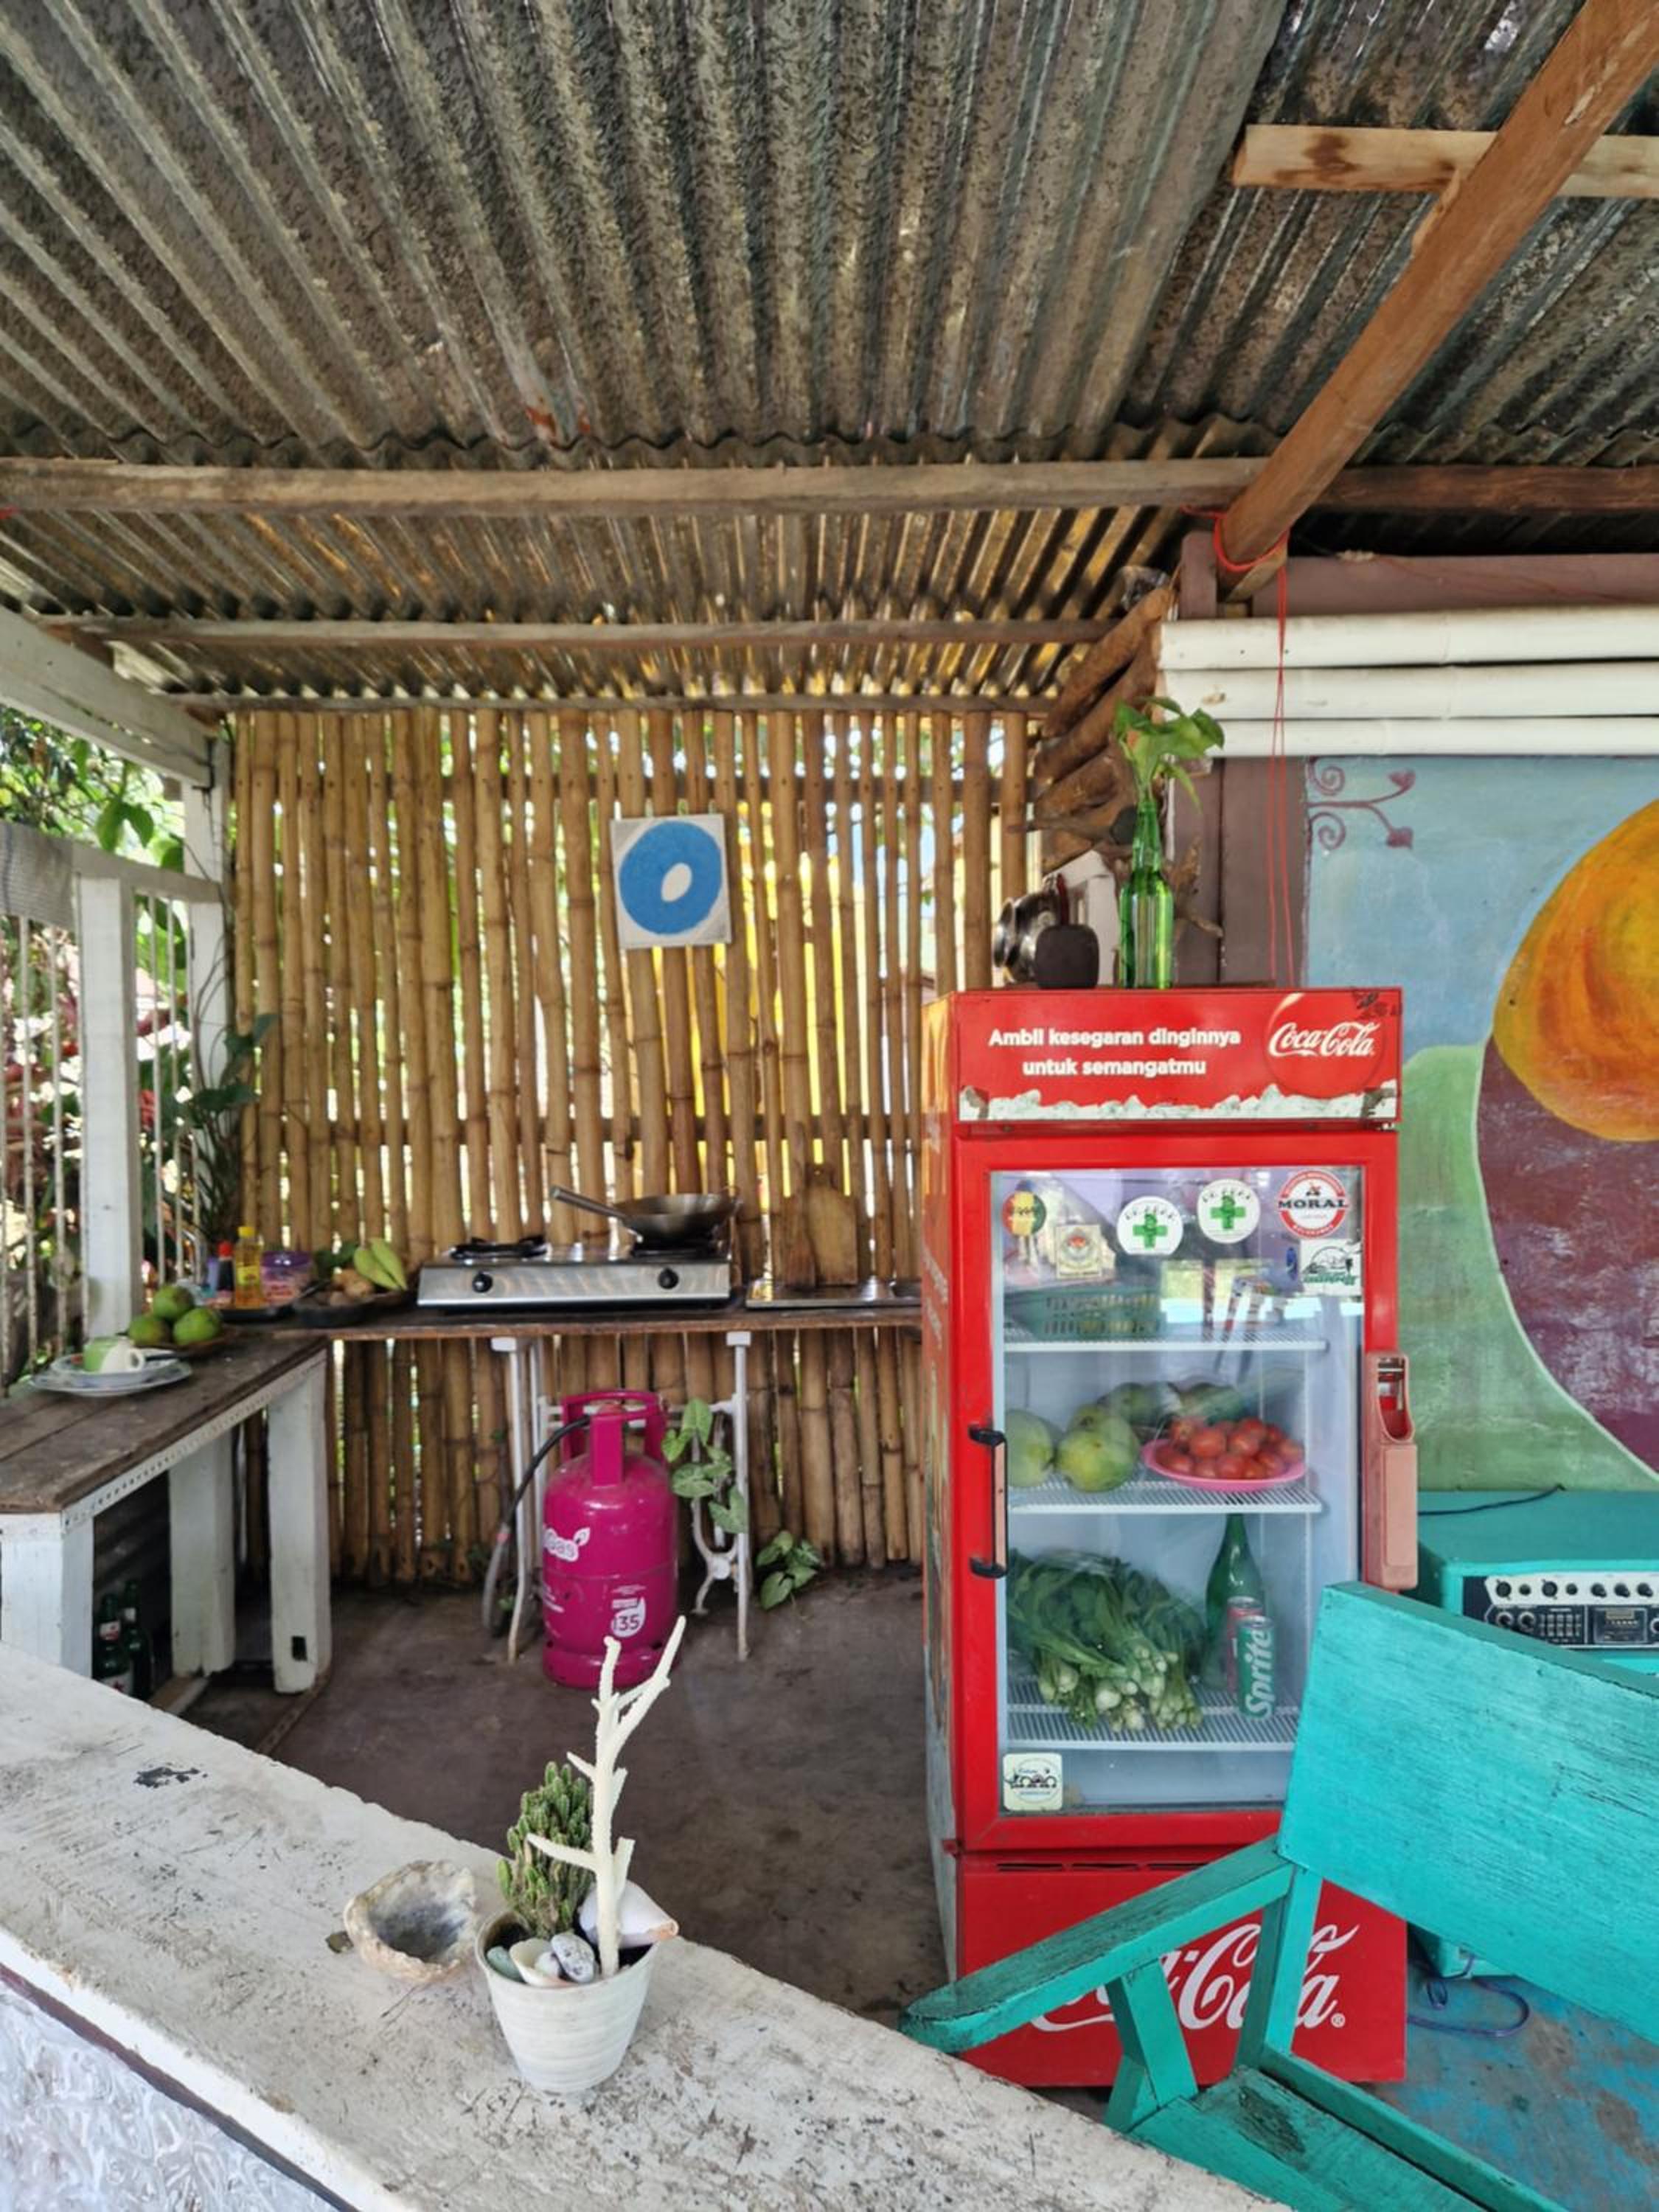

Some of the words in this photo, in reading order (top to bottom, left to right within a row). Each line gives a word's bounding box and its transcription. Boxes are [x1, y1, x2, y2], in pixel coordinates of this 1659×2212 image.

[989, 1028, 1044, 1046] Ambil
[1048, 1028, 1143, 1048] kesegaran
[1149, 1028, 1241, 1048] dinginnya
[1268, 1022, 1380, 1057] Coca-Cola
[1022, 1057, 1077, 1075] untuk
[1082, 1058, 1206, 1078] semangatmu
[1245, 1627, 1276, 1719] Sprite
